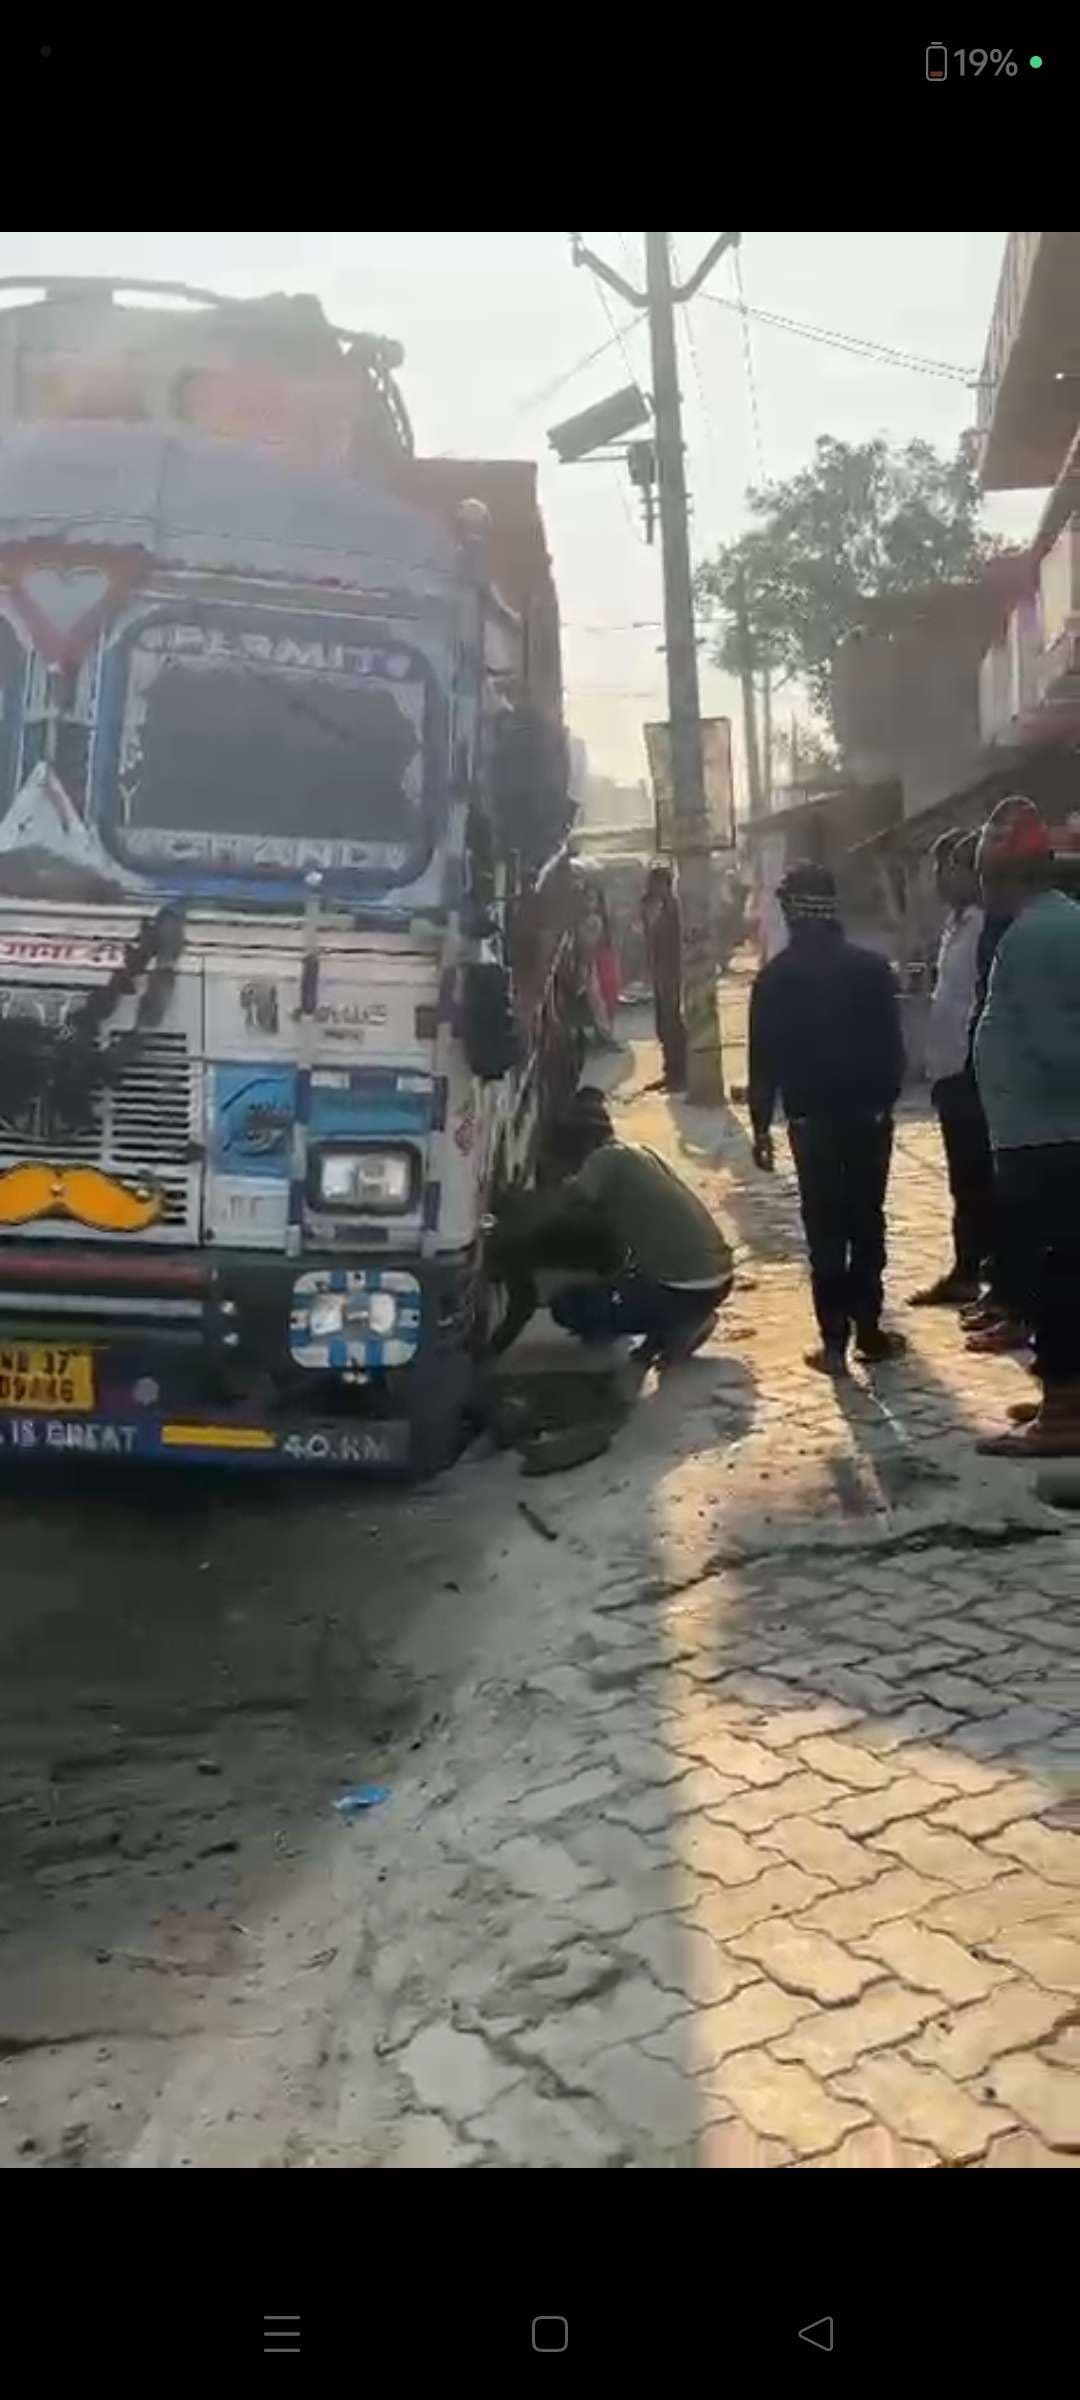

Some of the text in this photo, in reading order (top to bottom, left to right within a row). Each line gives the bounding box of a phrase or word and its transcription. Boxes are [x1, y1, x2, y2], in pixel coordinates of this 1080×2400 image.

[174, 624, 378, 675] PERMIT
[11, 1419, 137, 1452] IS GREAT
